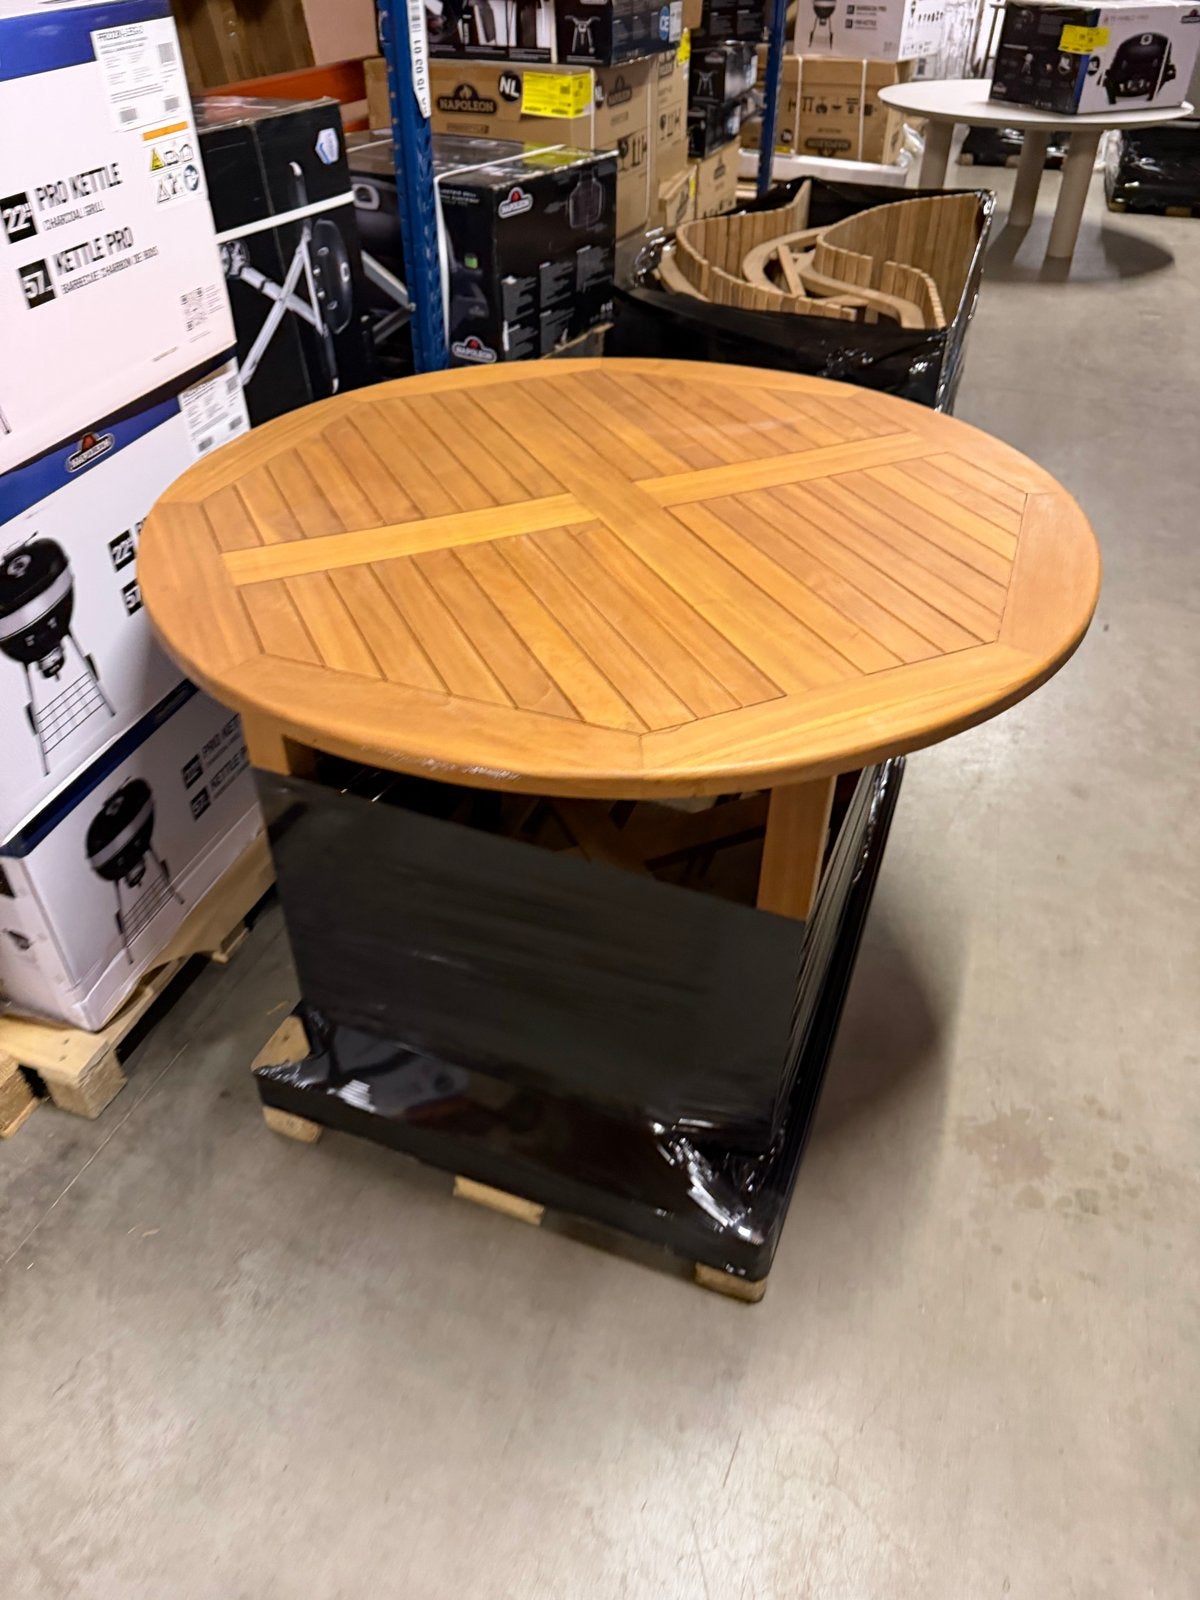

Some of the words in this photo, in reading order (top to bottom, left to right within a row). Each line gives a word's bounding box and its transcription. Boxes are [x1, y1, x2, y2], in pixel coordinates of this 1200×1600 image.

[439, 98, 495, 112] NAPOLEON
[500, 75, 520, 99] NL
[34, 180, 70, 212] PRO
[68, 161, 124, 201] KETTLE
[52, 237, 106, 277] KETTLE
[104, 225, 135, 256] PRO
